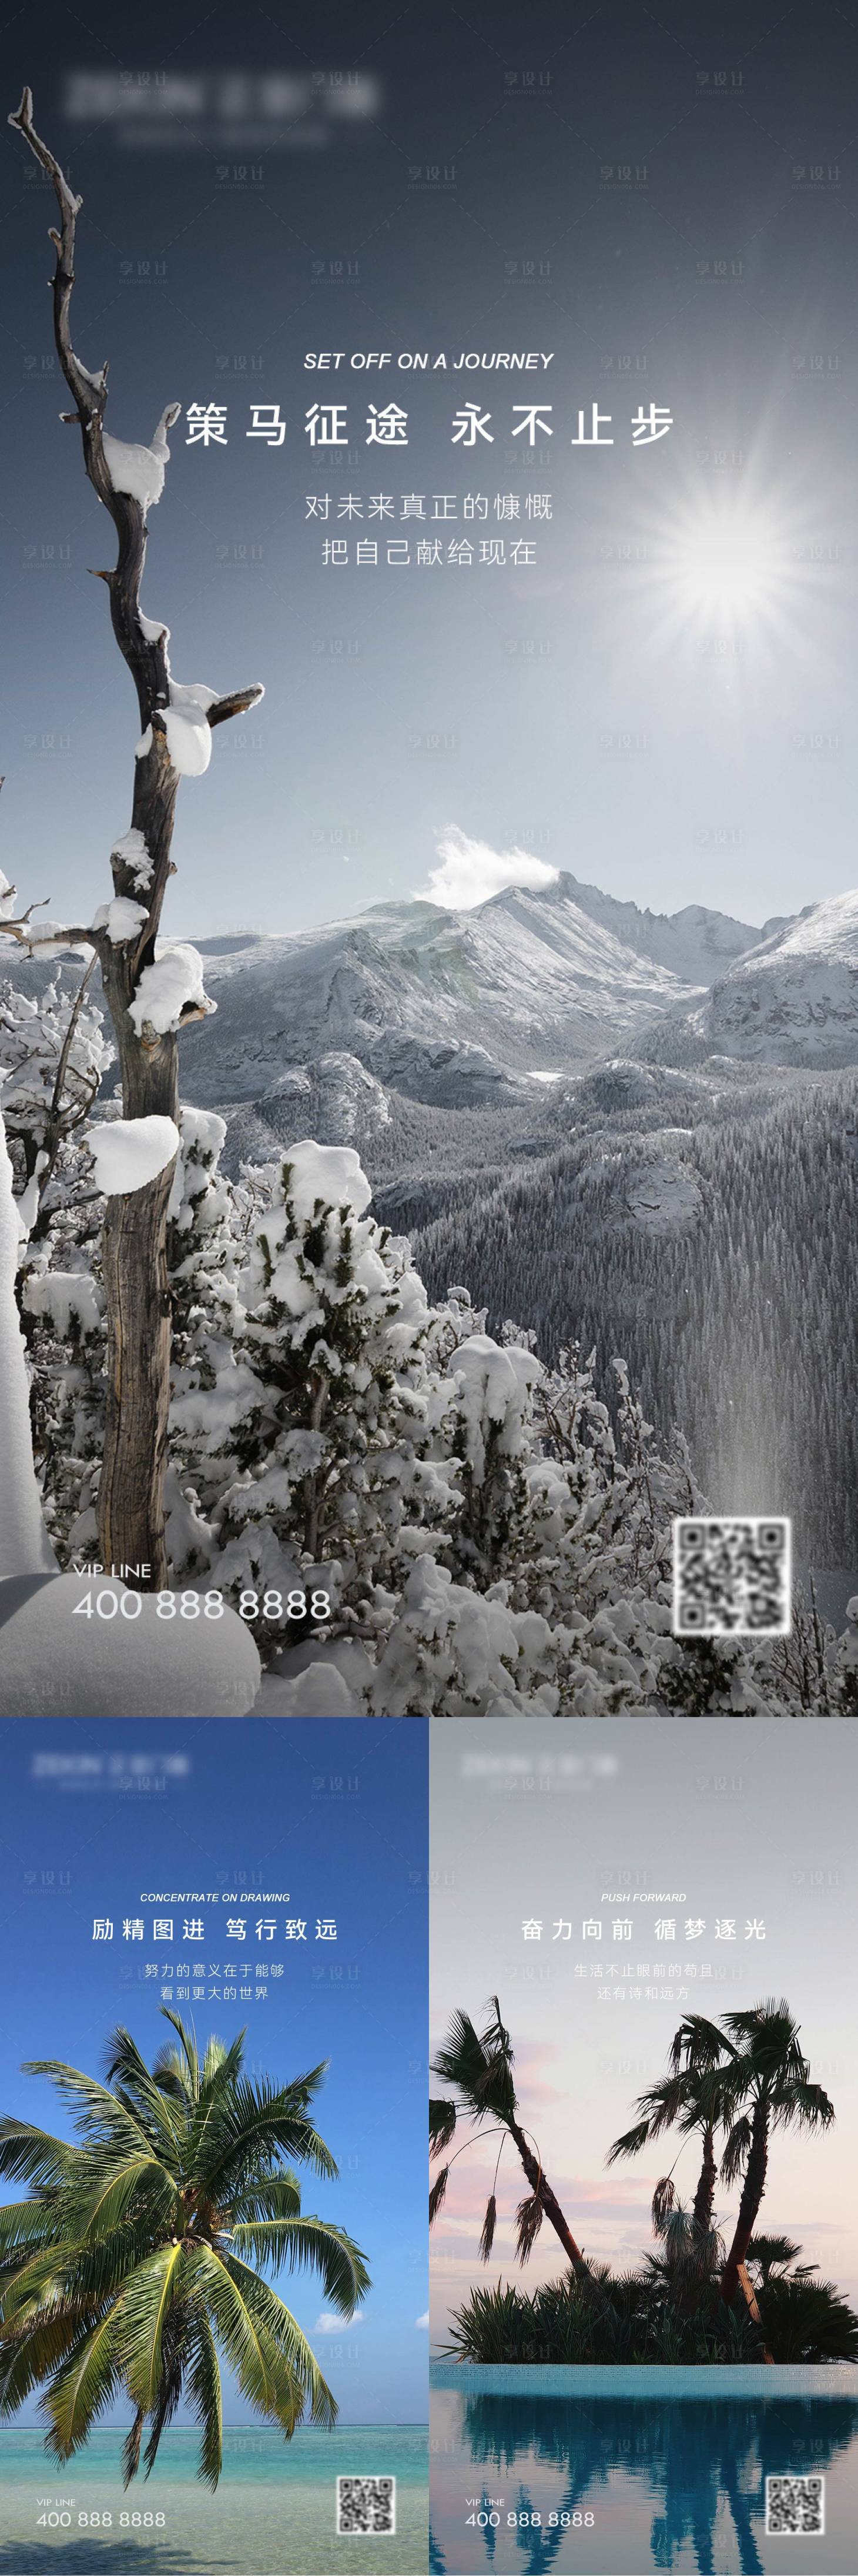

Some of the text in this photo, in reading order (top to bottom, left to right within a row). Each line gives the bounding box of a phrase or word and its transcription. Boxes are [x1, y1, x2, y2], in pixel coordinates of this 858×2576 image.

[304, 353, 346, 369] SET
[351, 353, 392, 369] OFF
[398, 353, 428, 369] ON
[433, 353, 447, 369] A
[453, 353, 555, 369] JOURNEY
[185, 402, 673, 446] 策马征途 永不止步
[305, 493, 553, 520] 对未来真正的慷慨
[321, 538, 537, 566] 把自己献给现在
[72, 1564, 151, 1578] VIP LINE
[72, 1590, 331, 1619] 400 888 8888
[140, 1893, 291, 1902] CONCENTRATE ON DRAWING
[601, 1893, 686, 1902] PUSH FORWARD
[92, 1918, 338, 1940] 励精图进 笃行致远
[521, 1918, 766, 1940] 奋力向前 循梦逐光
[144, 1963, 284, 1978] 努力的意义在于能够
[573, 1963, 714, 1978] 生活不止眼前的苟且
[160, 1986, 269, 2000] 看到更大的世界
[596, 1986, 691, 2000] 还有诗和远方
[36, 2498, 76, 2507] VIP LINE
[465, 2498, 505, 2507] VIP LINE
[36, 2512, 166, 2527] 400 888 8888
[465, 2512, 595, 2527] 400 888 8888
